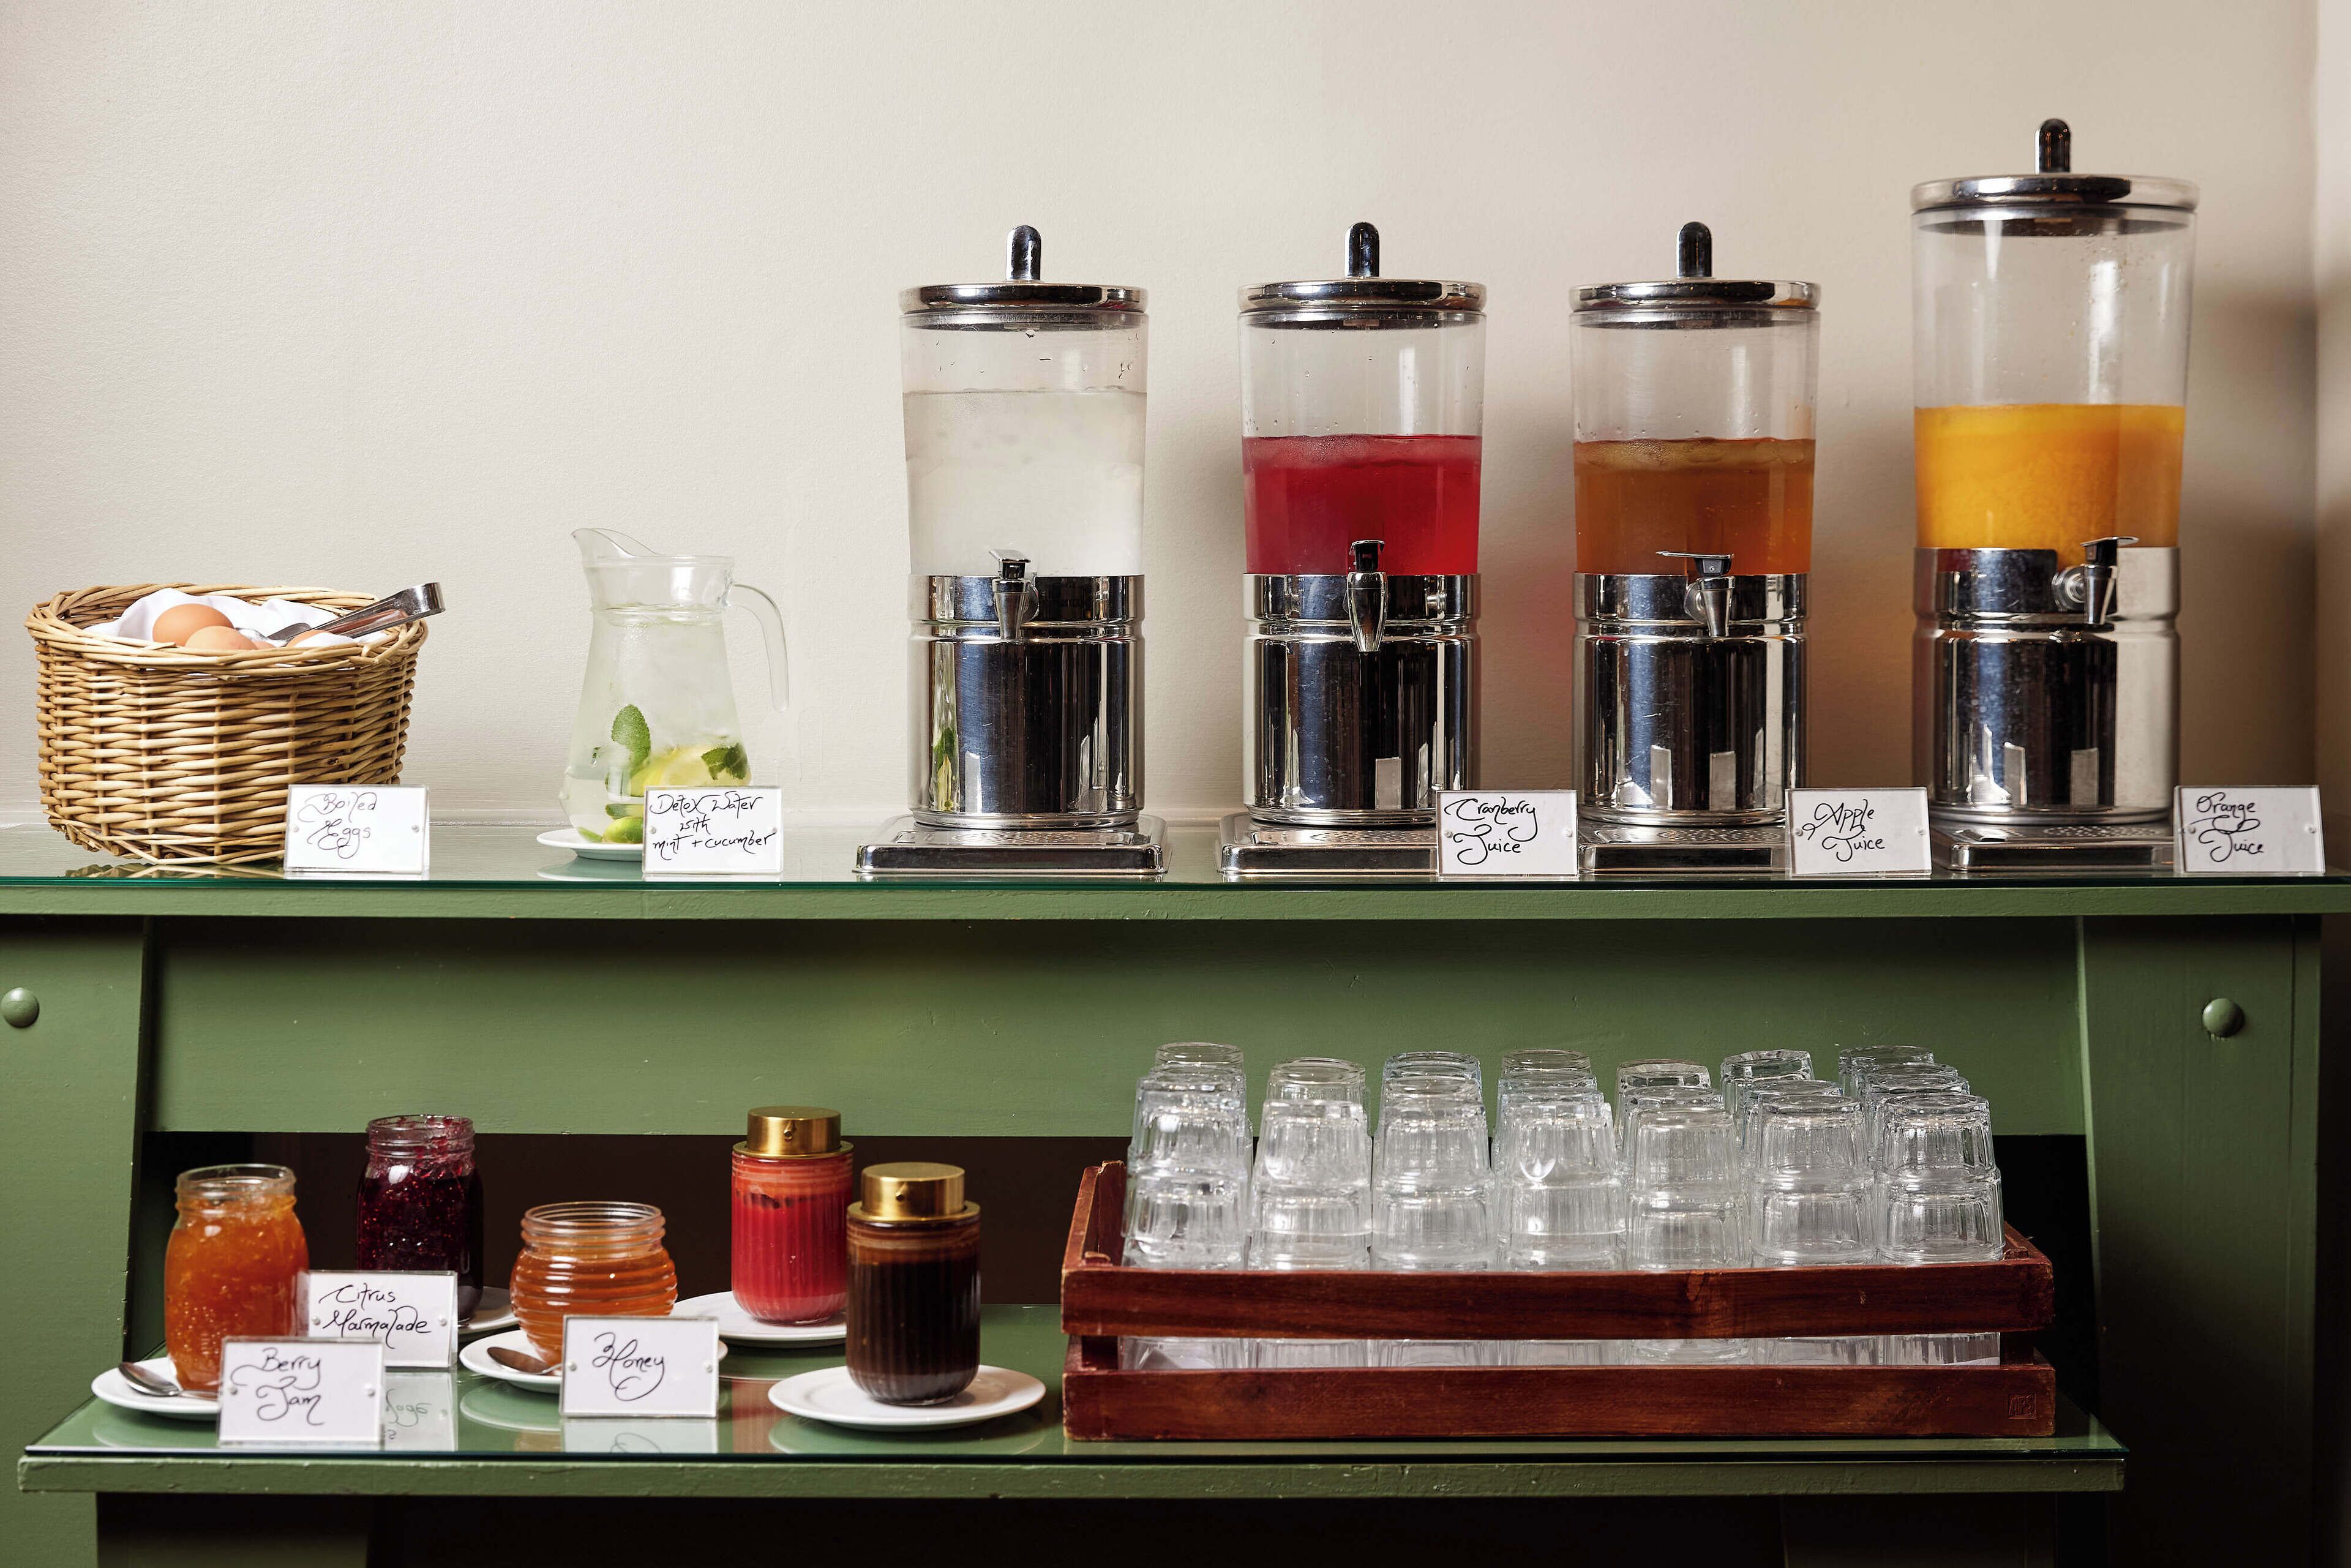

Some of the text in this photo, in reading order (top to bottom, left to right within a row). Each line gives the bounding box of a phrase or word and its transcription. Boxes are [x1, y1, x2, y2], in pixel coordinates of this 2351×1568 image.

[298, 792, 377, 823] Boiled
[650, 791, 763, 819] Detox Water
[1444, 796, 1538, 842] Cranberry
[1802, 798, 1875, 841] Apple
[2192, 792, 2260, 830] Orange
[307, 818, 370, 859] Eggs
[653, 830, 776, 860] mint + cucumber
[1453, 823, 1522, 865] Juice
[1821, 831, 1885, 862] Juice
[2198, 827, 2265, 863] Juice
[318, 1282, 396, 1311] Citrus
[322, 1305, 432, 1349] Marmalade
[230, 1347, 322, 1391] Berry
[592, 1332, 665, 1401] Honey
[256, 1376, 324, 1426] Jam
